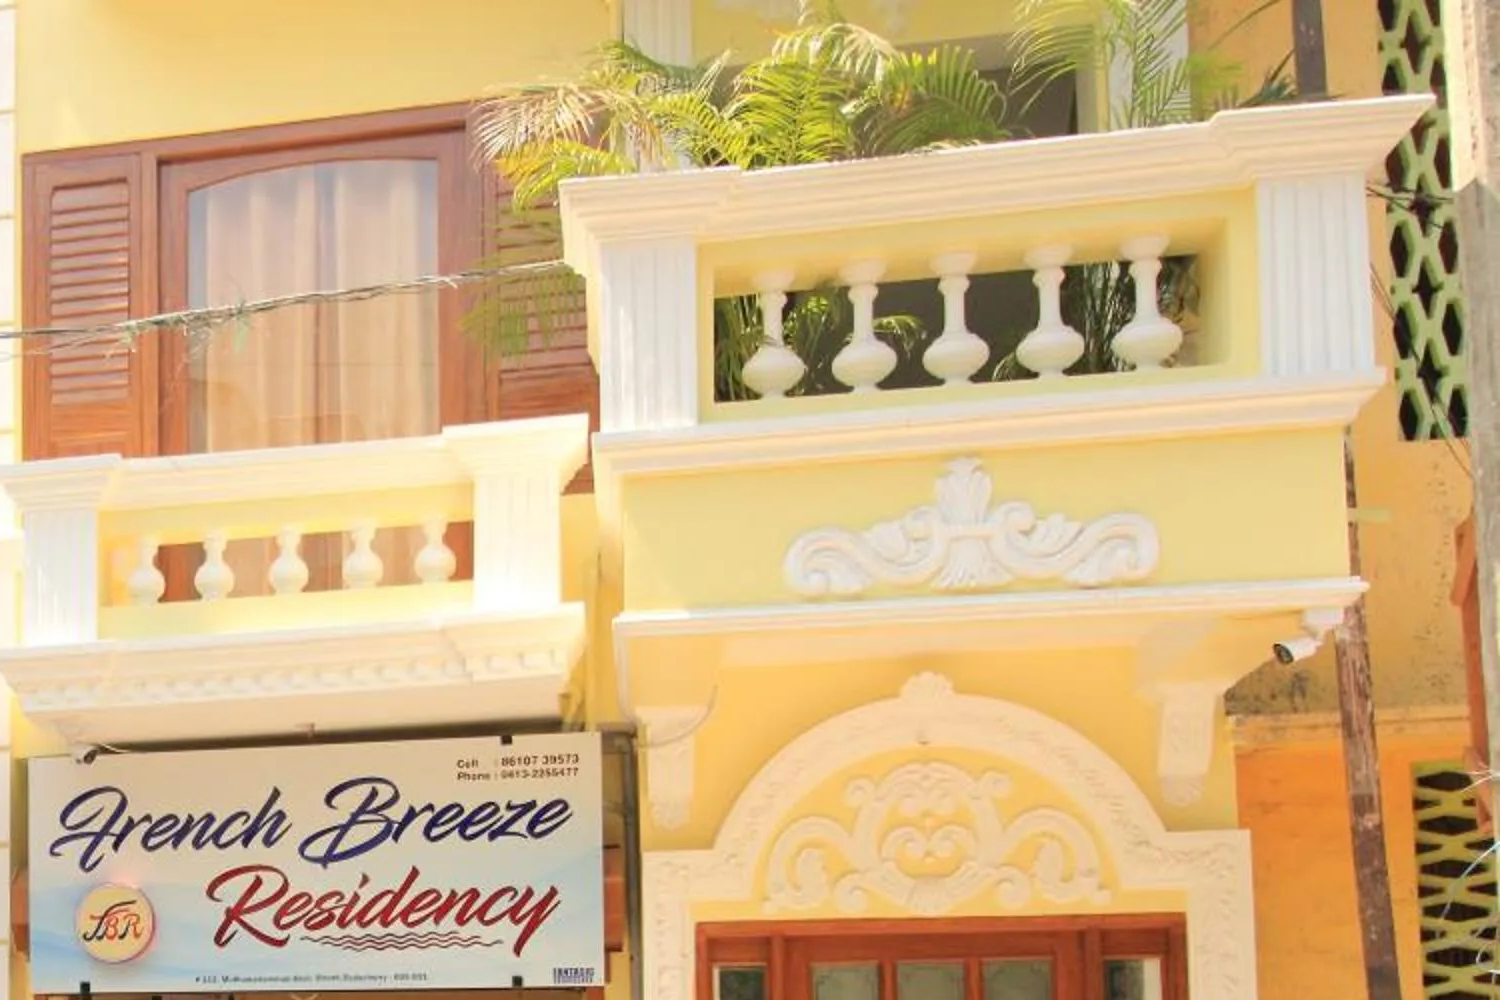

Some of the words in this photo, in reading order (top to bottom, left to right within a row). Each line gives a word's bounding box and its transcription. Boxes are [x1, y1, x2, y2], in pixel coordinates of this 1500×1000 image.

[457, 759, 479, 768] Cell
[457, 771, 491, 781] Phone
[49, 785, 292, 874] French
[299, 776, 573, 868] Breeze
[206, 864, 561, 957] Residency
